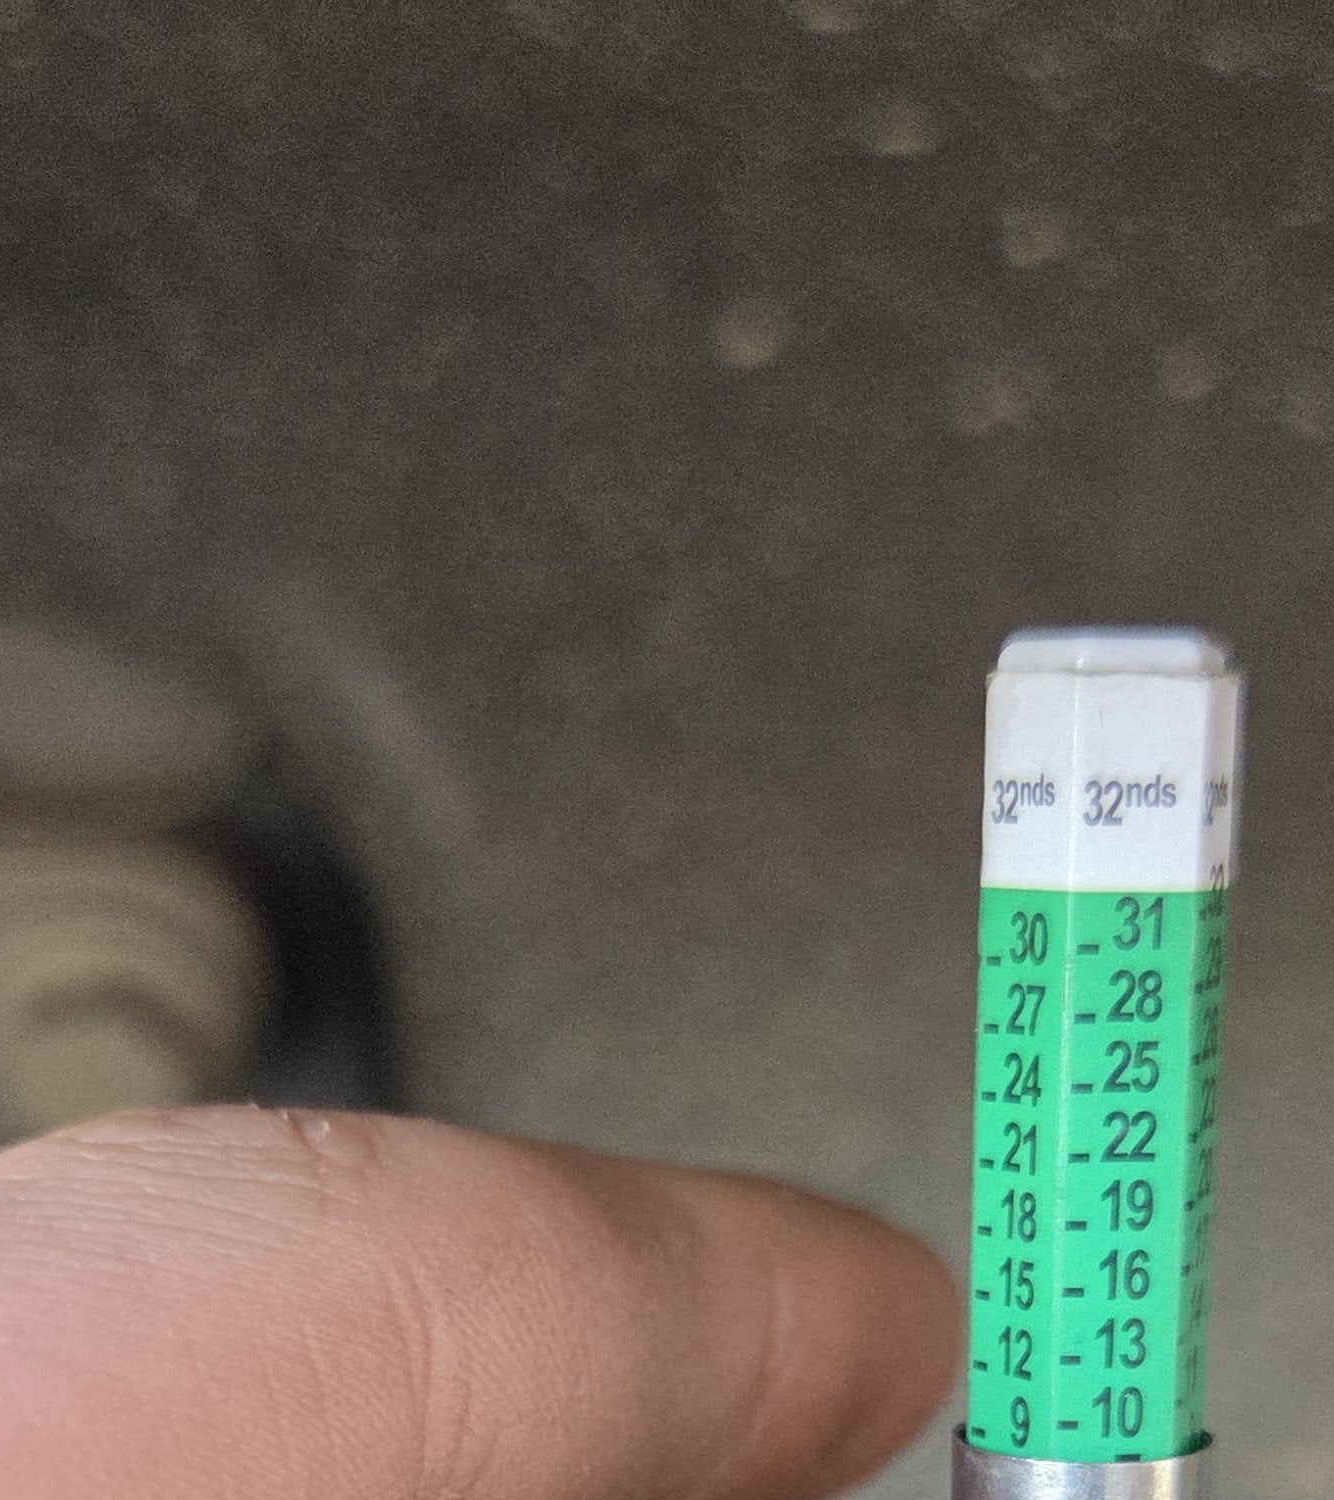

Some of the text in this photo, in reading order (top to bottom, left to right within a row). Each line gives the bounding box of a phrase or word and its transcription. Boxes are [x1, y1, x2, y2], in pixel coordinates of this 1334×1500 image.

[991, 773, 1055, 824] 32nds
[1083, 774, 1177, 826] 32nds
[1009, 911, 1048, 965] 30
[1113, 896, 1164, 950] 31
[1006, 983, 1045, 1036] 27
[1106, 970, 1163, 1022] 28
[1003, 1052, 1041, 1107] 24
[1102, 1040, 1159, 1093] 25
[1001, 1121, 1037, 1175] 21
[1100, 1110, 1157, 1162] 22
[1001, 1189, 1036, 1243] 18
[1101, 1179, 1153, 1231] 19
[999, 1257, 1034, 1311] 15
[1099, 1249, 1150, 1301] 16
[998, 1326, 1032, 1381] 12
[1095, 1318, 1146, 1369] 13
[1010, 1396, 1030, 1448] 9
[1092, 1386, 1144, 1438] 10
